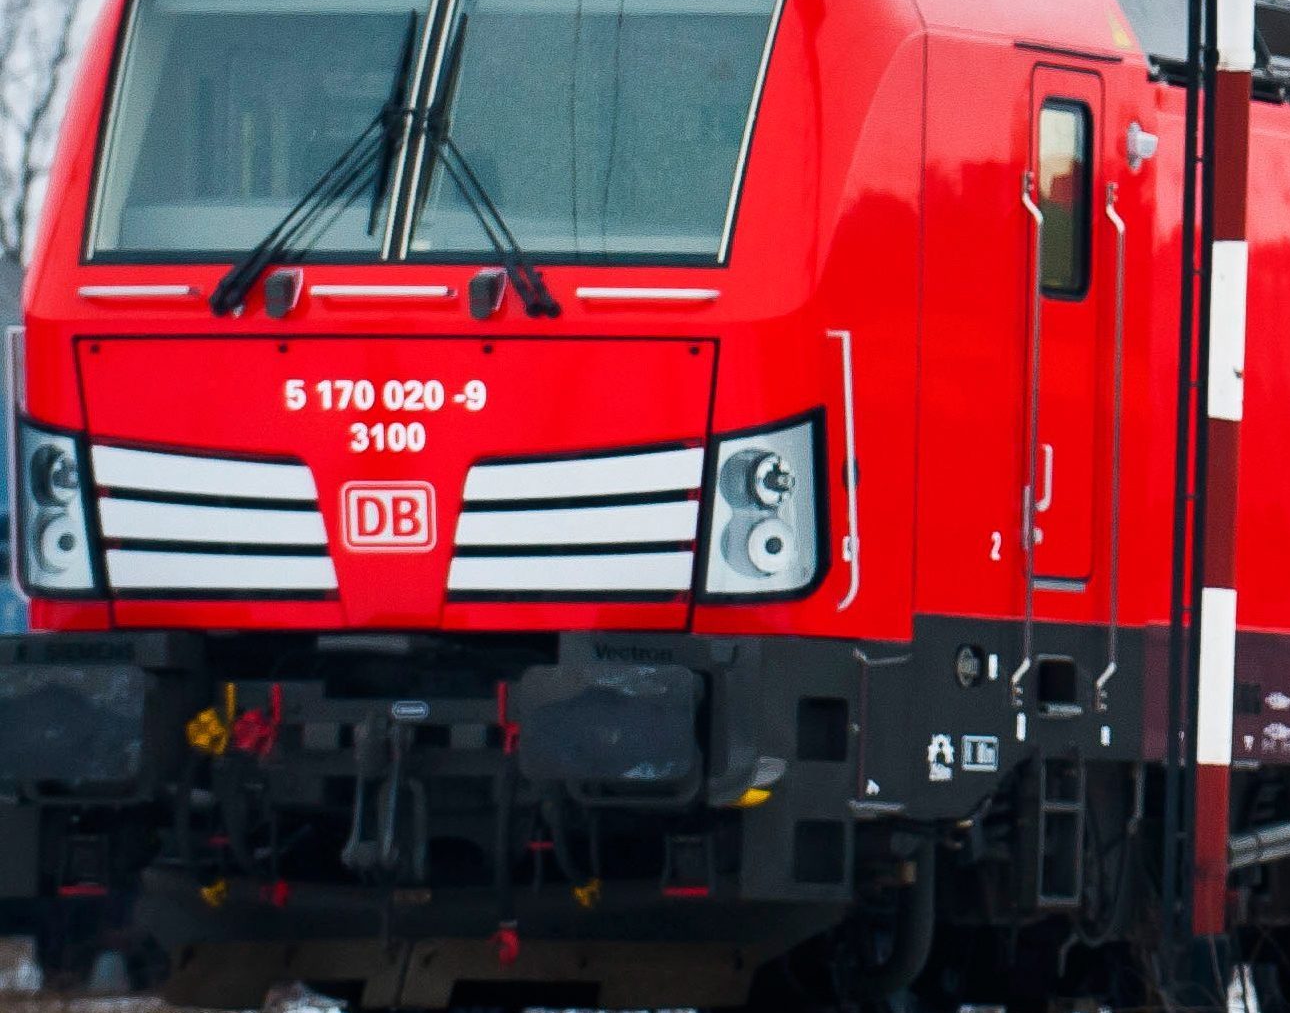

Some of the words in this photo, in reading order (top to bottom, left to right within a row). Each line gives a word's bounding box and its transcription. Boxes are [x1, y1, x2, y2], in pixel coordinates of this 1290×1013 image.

[285, 379, 307, 411] 5
[316, 379, 375, 411] 170
[383, 379, 445, 412] 020
[350, 421, 426, 453] 3100
[356, 496, 422, 537] DB
